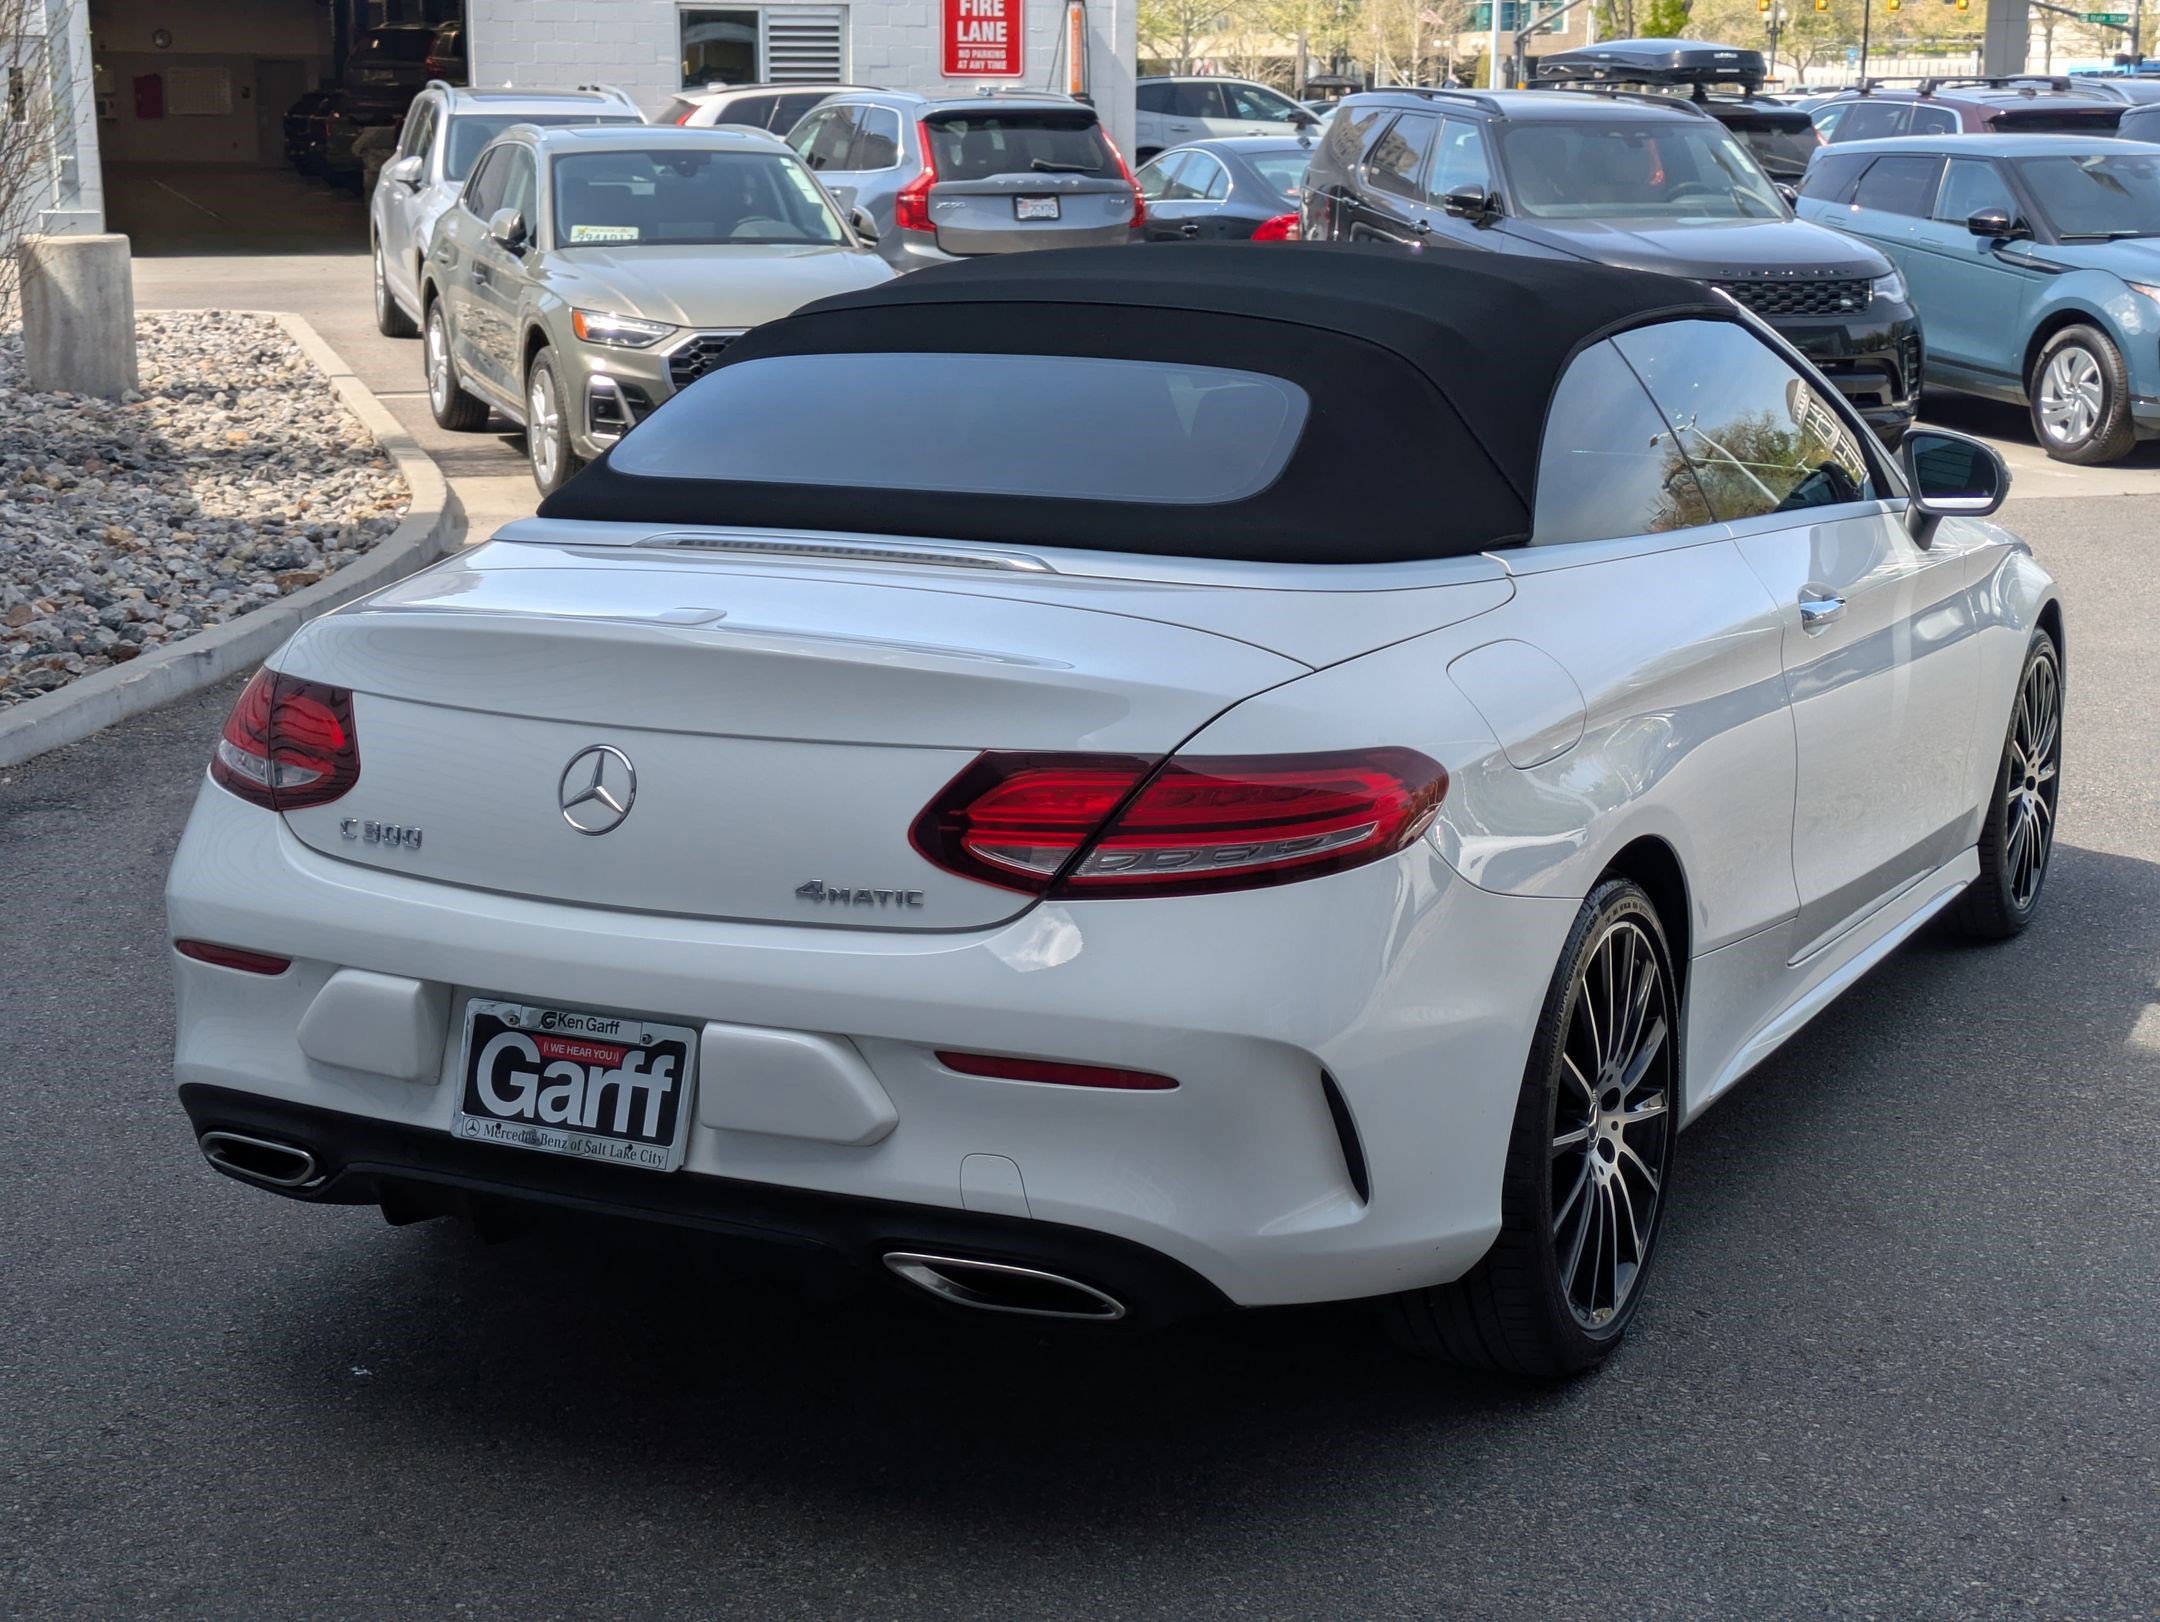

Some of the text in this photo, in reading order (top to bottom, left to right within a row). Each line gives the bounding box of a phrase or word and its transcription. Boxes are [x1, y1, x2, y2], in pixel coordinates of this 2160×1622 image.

[959, 0, 1006, 17] FIRE
[957, 21, 1008, 42] LANE
[958, 49, 1007, 59] NO PARKING
[957, 60, 1008, 70] AT ANY TIME
[340, 818, 358, 840] C
[795, 879, 924, 906] 4MATIC
[557, 1012, 620, 1035] Ken Garff
[550, 1043, 613, 1060] WE HEAR YOU
[476, 1031, 675, 1138] Garff
[540, 1133, 568, 1149] Benz
[570, 1139, 582, 1152] of
[585, 1138, 606, 1156] Salt
[610, 1145, 637, 1161] Lake
[640, 1149, 665, 1168] City
